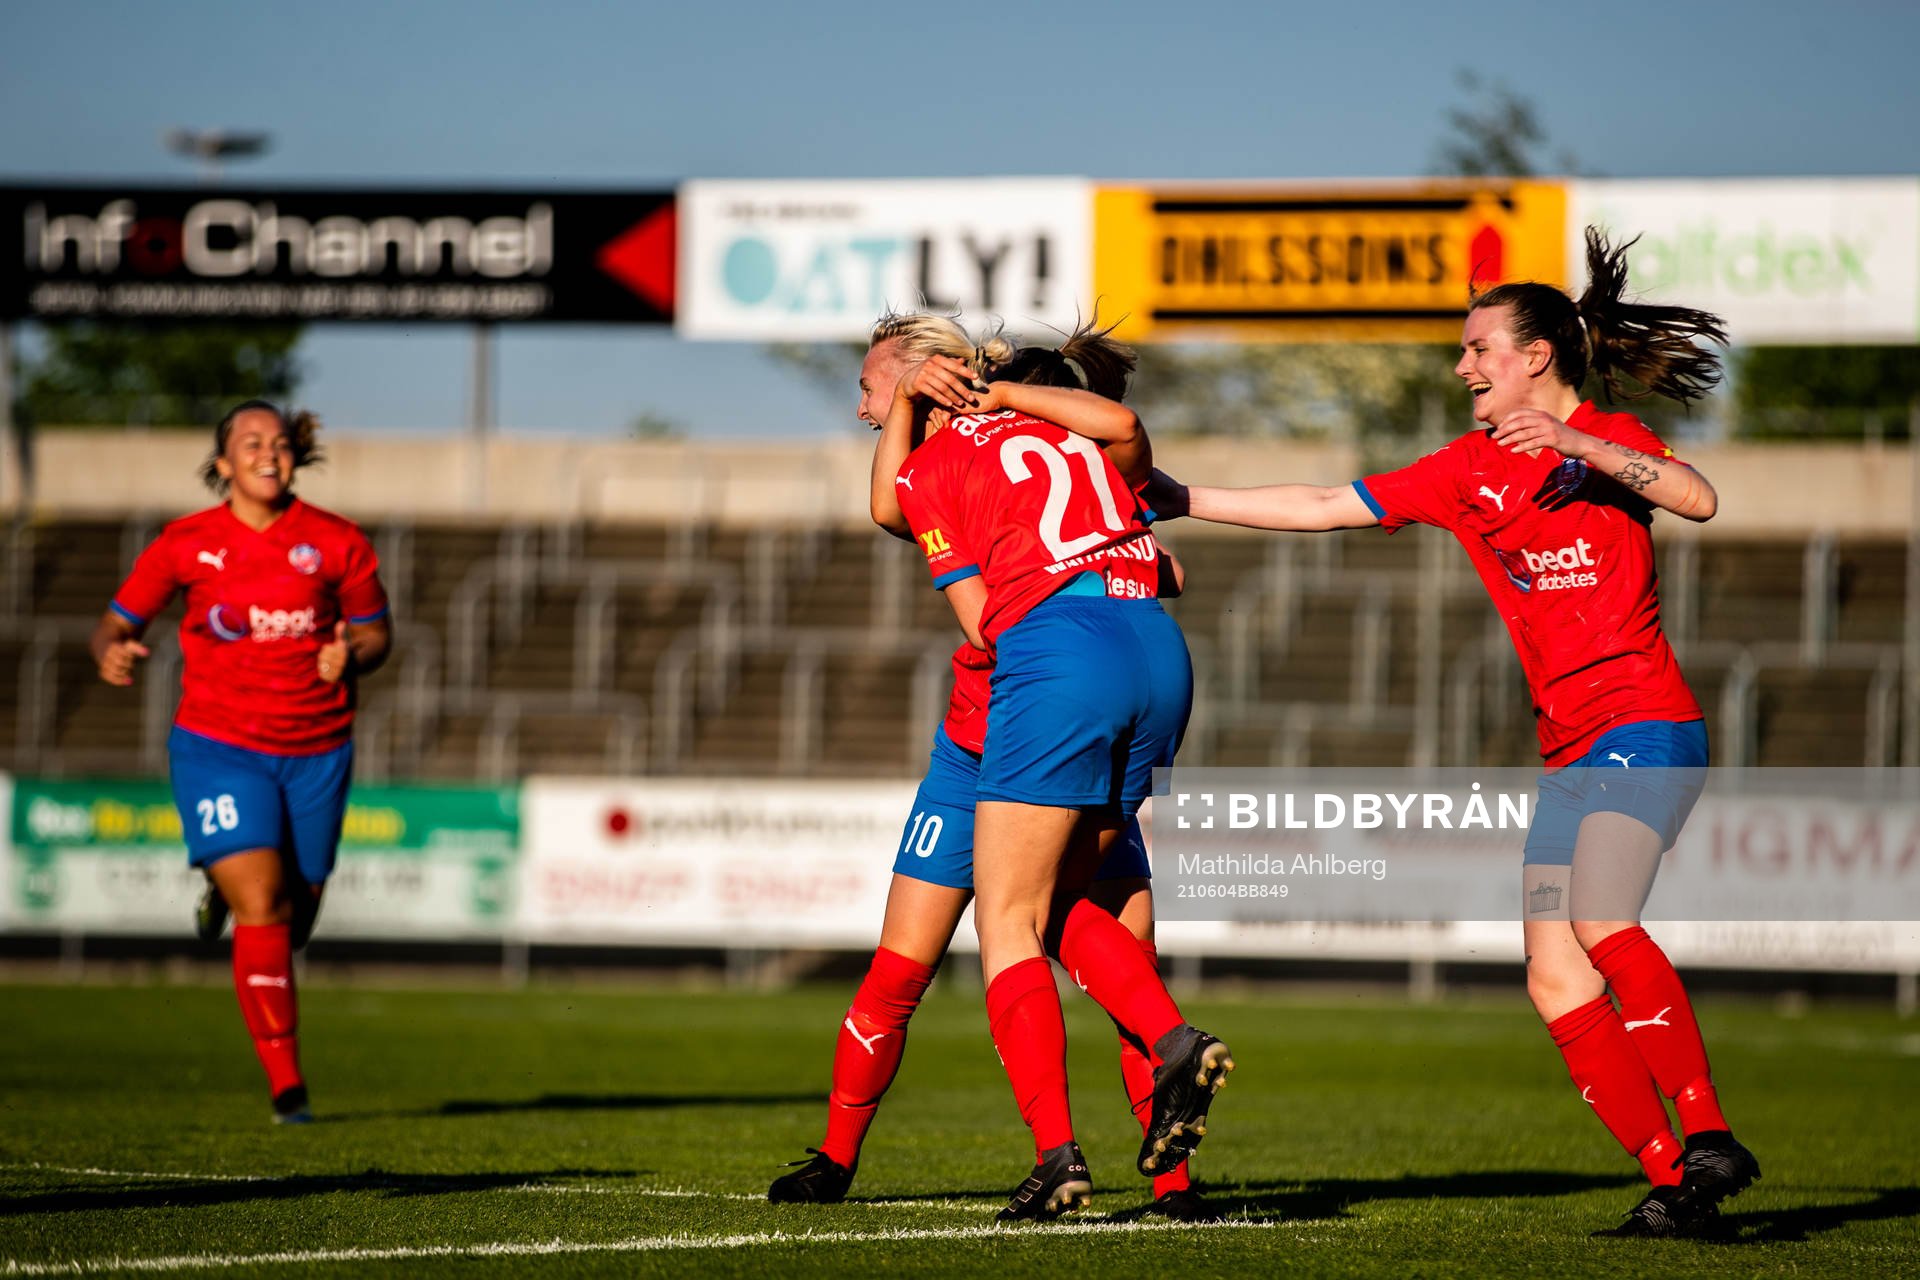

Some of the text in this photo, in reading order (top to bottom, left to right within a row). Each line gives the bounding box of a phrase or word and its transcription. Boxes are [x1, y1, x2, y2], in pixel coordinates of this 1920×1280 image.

[24, 199, 554, 278] InfoChannel
[722, 224, 1054, 314] OATLY!
[1521, 538, 1595, 573] beat
[1538, 571, 1597, 590] diabetes
[248, 603, 317, 633] beat
[197, 793, 240, 836] 26
[904, 810, 944, 858] 10
